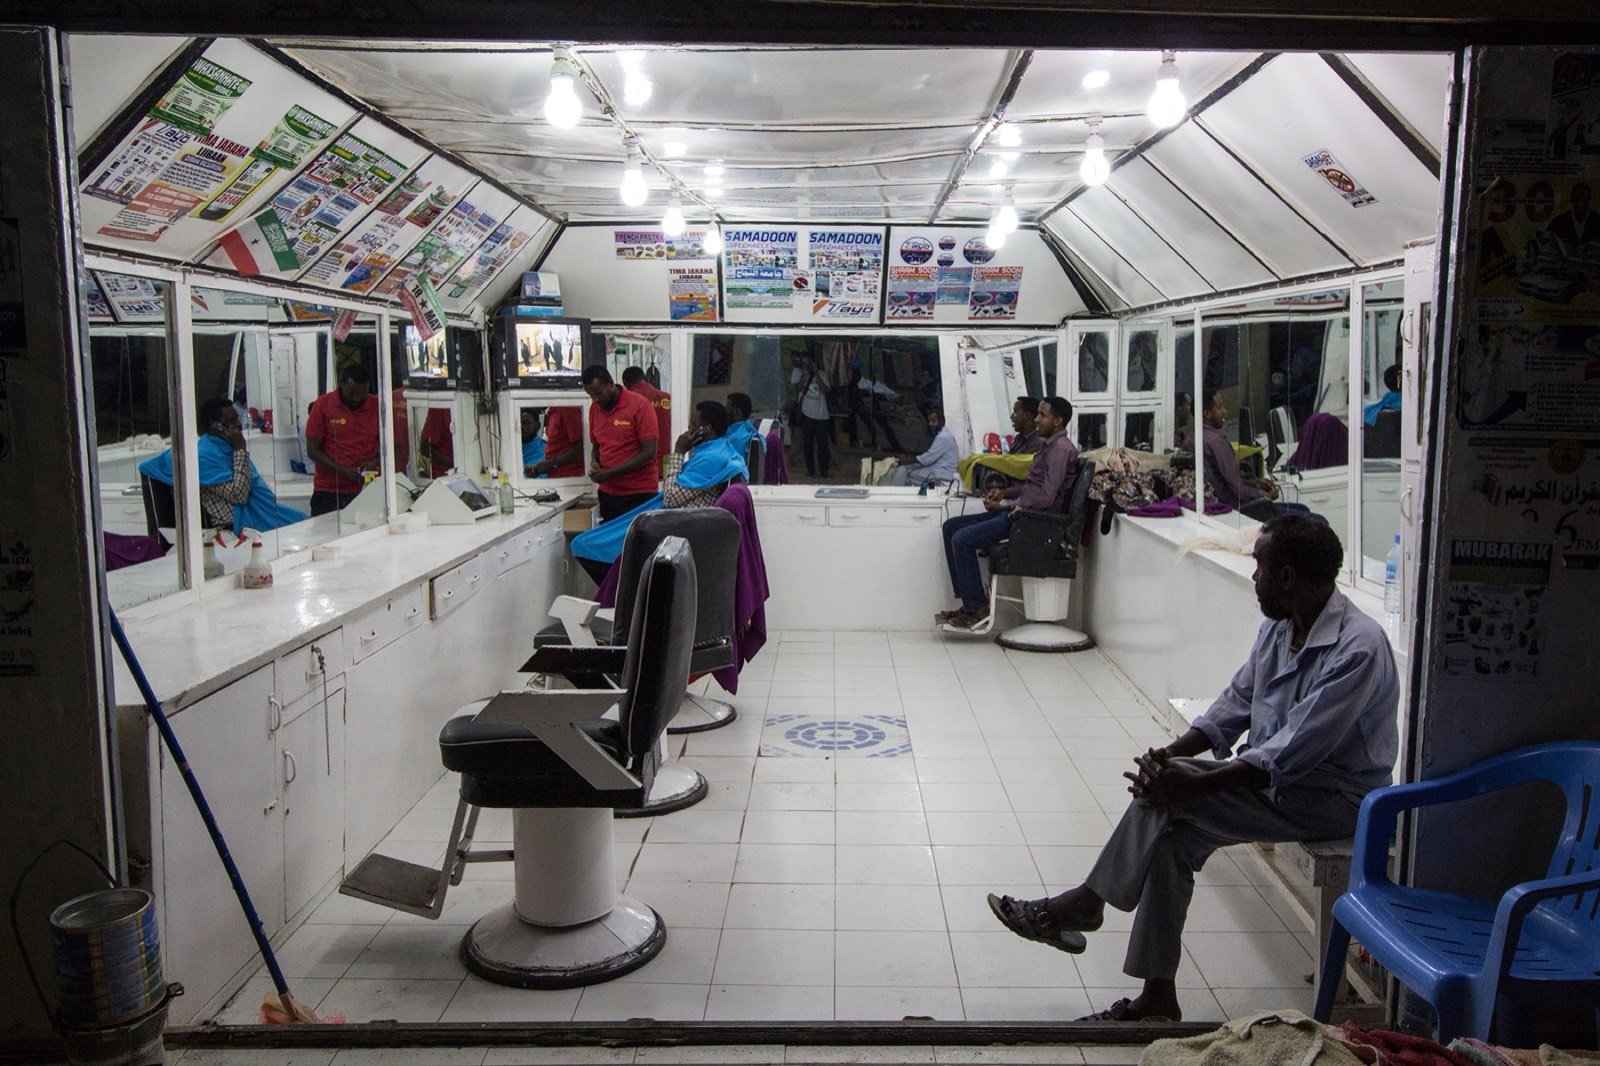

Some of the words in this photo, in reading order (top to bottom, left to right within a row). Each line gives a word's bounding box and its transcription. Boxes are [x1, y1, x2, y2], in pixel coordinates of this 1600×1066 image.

[157, 124, 191, 144] Tayo
[615, 233, 640, 241] FRENCH
[640, 233, 664, 241] PASTRY
[724, 231, 798, 243] SAMADOON
[809, 231, 883, 245] SAMADOON
[411, 284, 423, 298] 18
[828, 301, 875, 316] Tayo
[424, 309, 443, 331] MAY
[1454, 540, 1551, 561] MUBARAK
